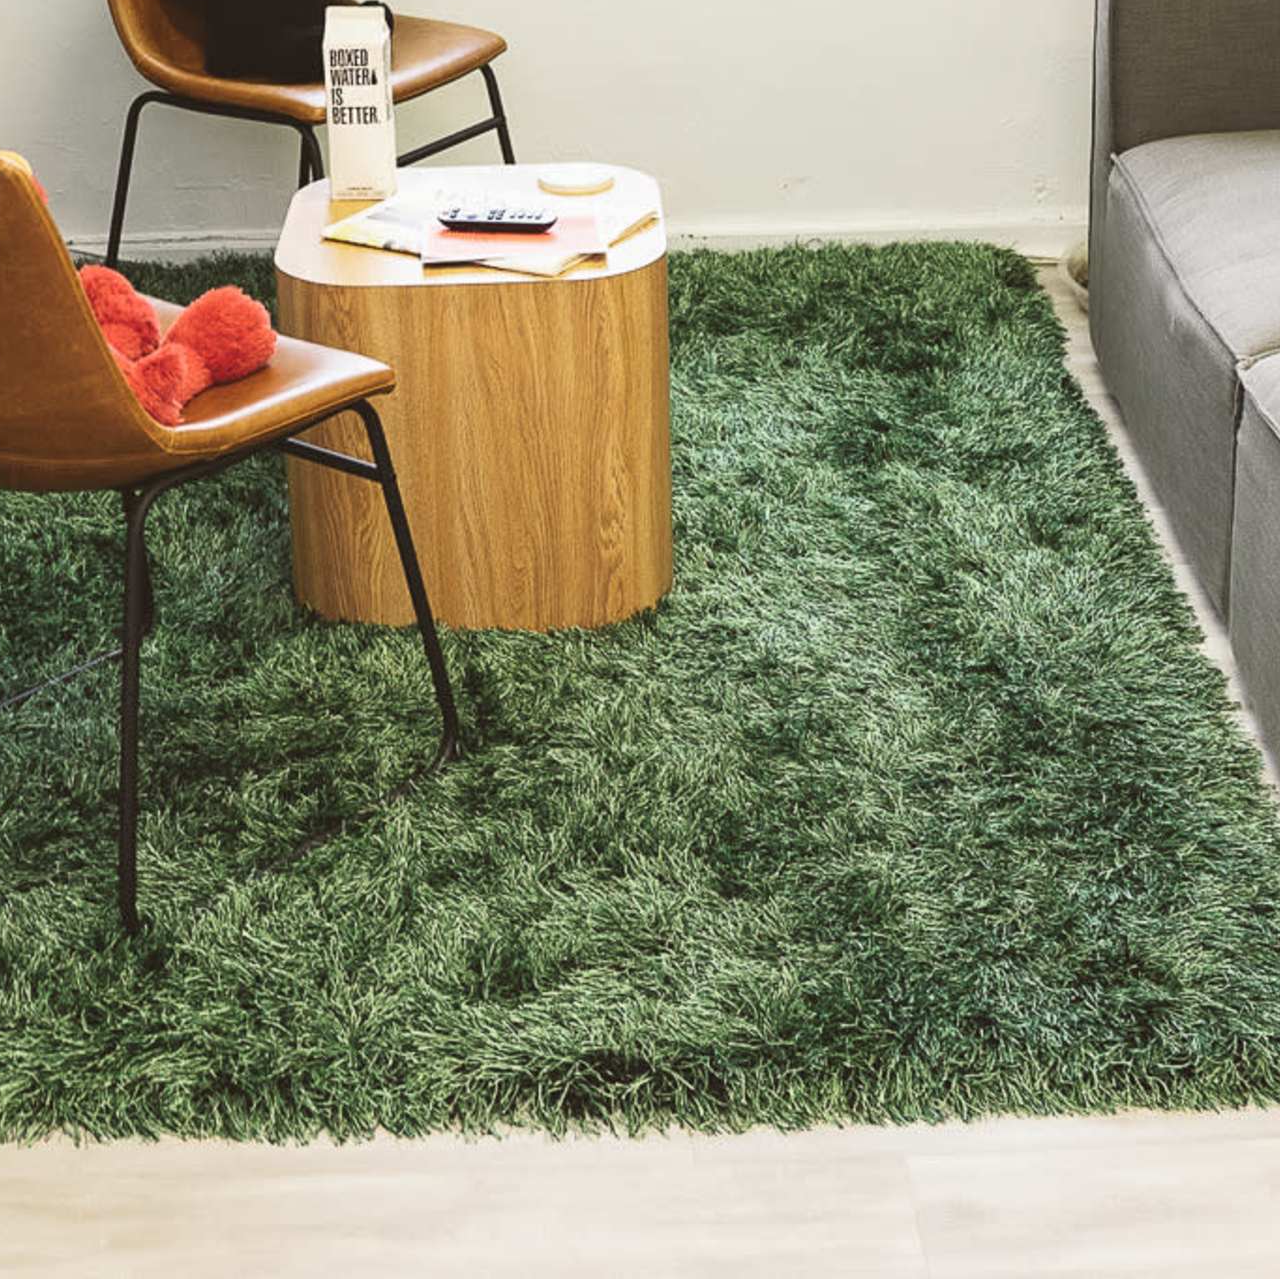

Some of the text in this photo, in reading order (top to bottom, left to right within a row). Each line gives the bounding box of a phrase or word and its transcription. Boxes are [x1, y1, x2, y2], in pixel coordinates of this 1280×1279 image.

[329, 48, 369, 67] BOXED
[329, 69, 371, 87] WATER
[332, 88, 344, 107] IS
